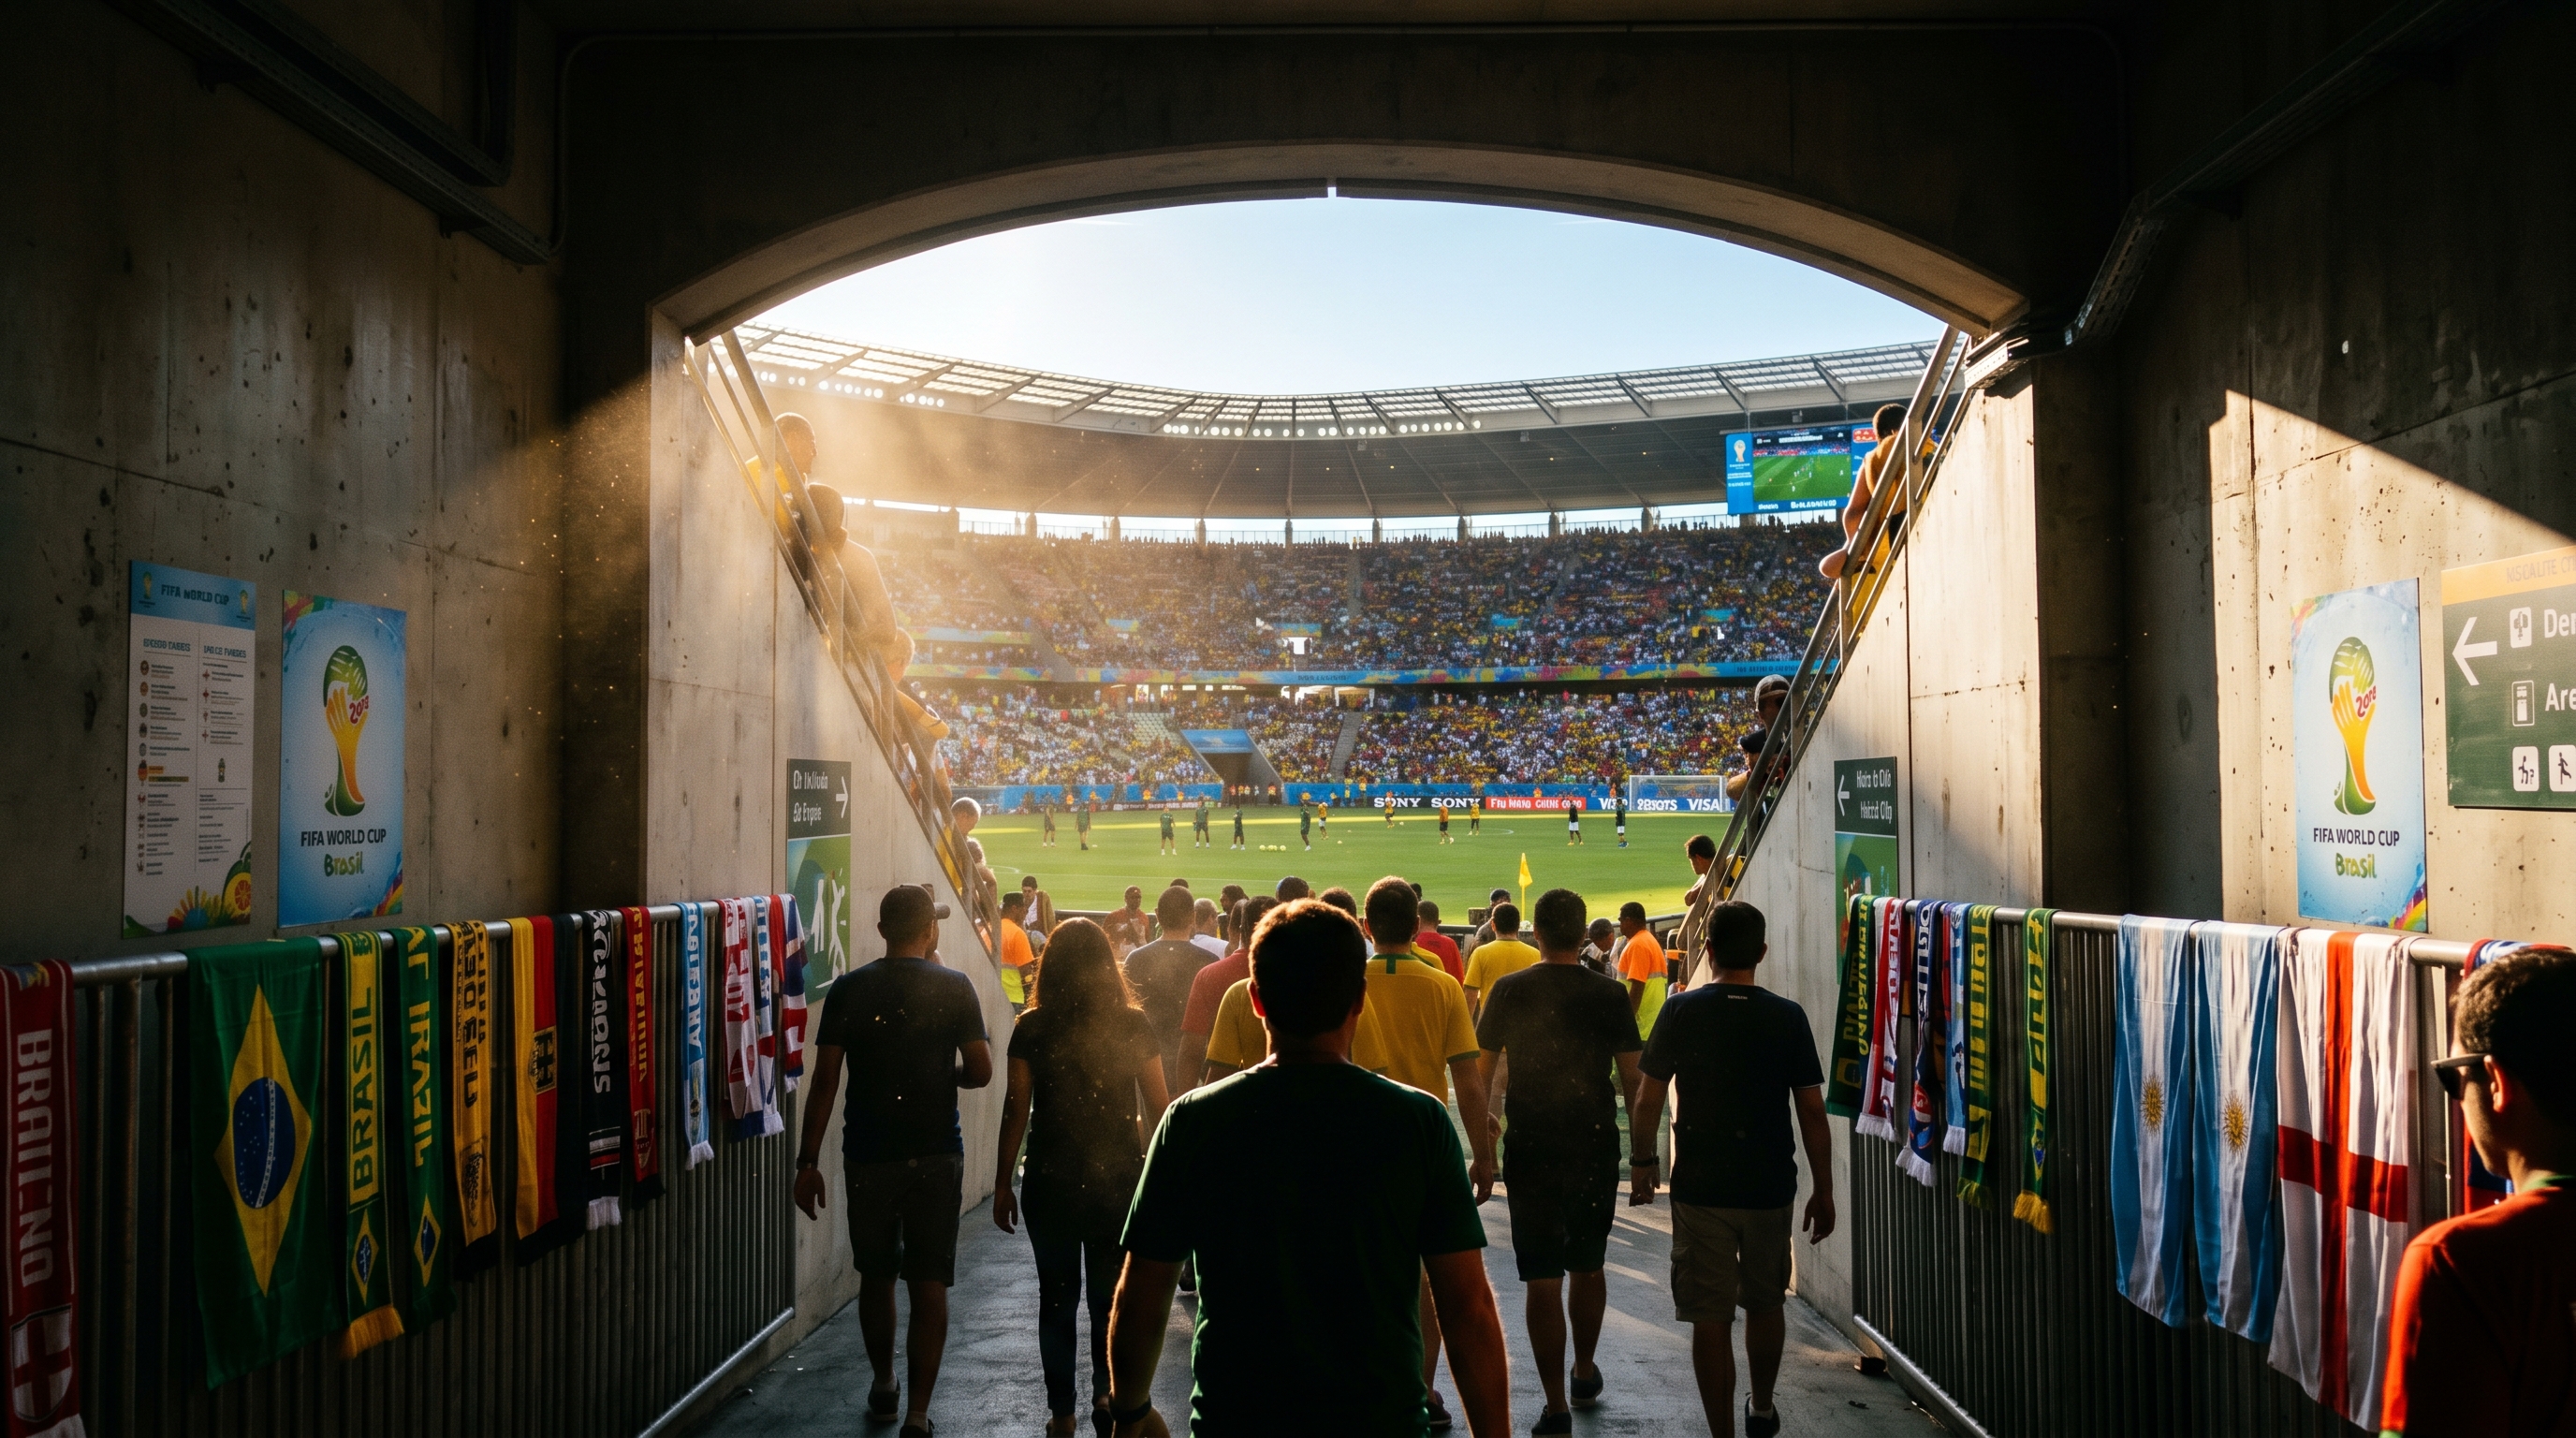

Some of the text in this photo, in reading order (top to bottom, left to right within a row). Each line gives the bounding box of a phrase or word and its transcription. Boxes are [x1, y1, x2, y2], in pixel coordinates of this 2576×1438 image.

[1374, 798, 1421, 807] SONY
[1431, 798, 1480, 807] SONY
[1687, 799, 1720, 810] VISA
[300, 829, 387, 846] FIFA WORLD CUP
[2313, 828, 2400, 846] FIFA WORLD CUP
[324, 851, 364, 876] Brasil
[2335, 853, 2377, 878] Brasil
[352, 987, 373, 1190] BRASIL
